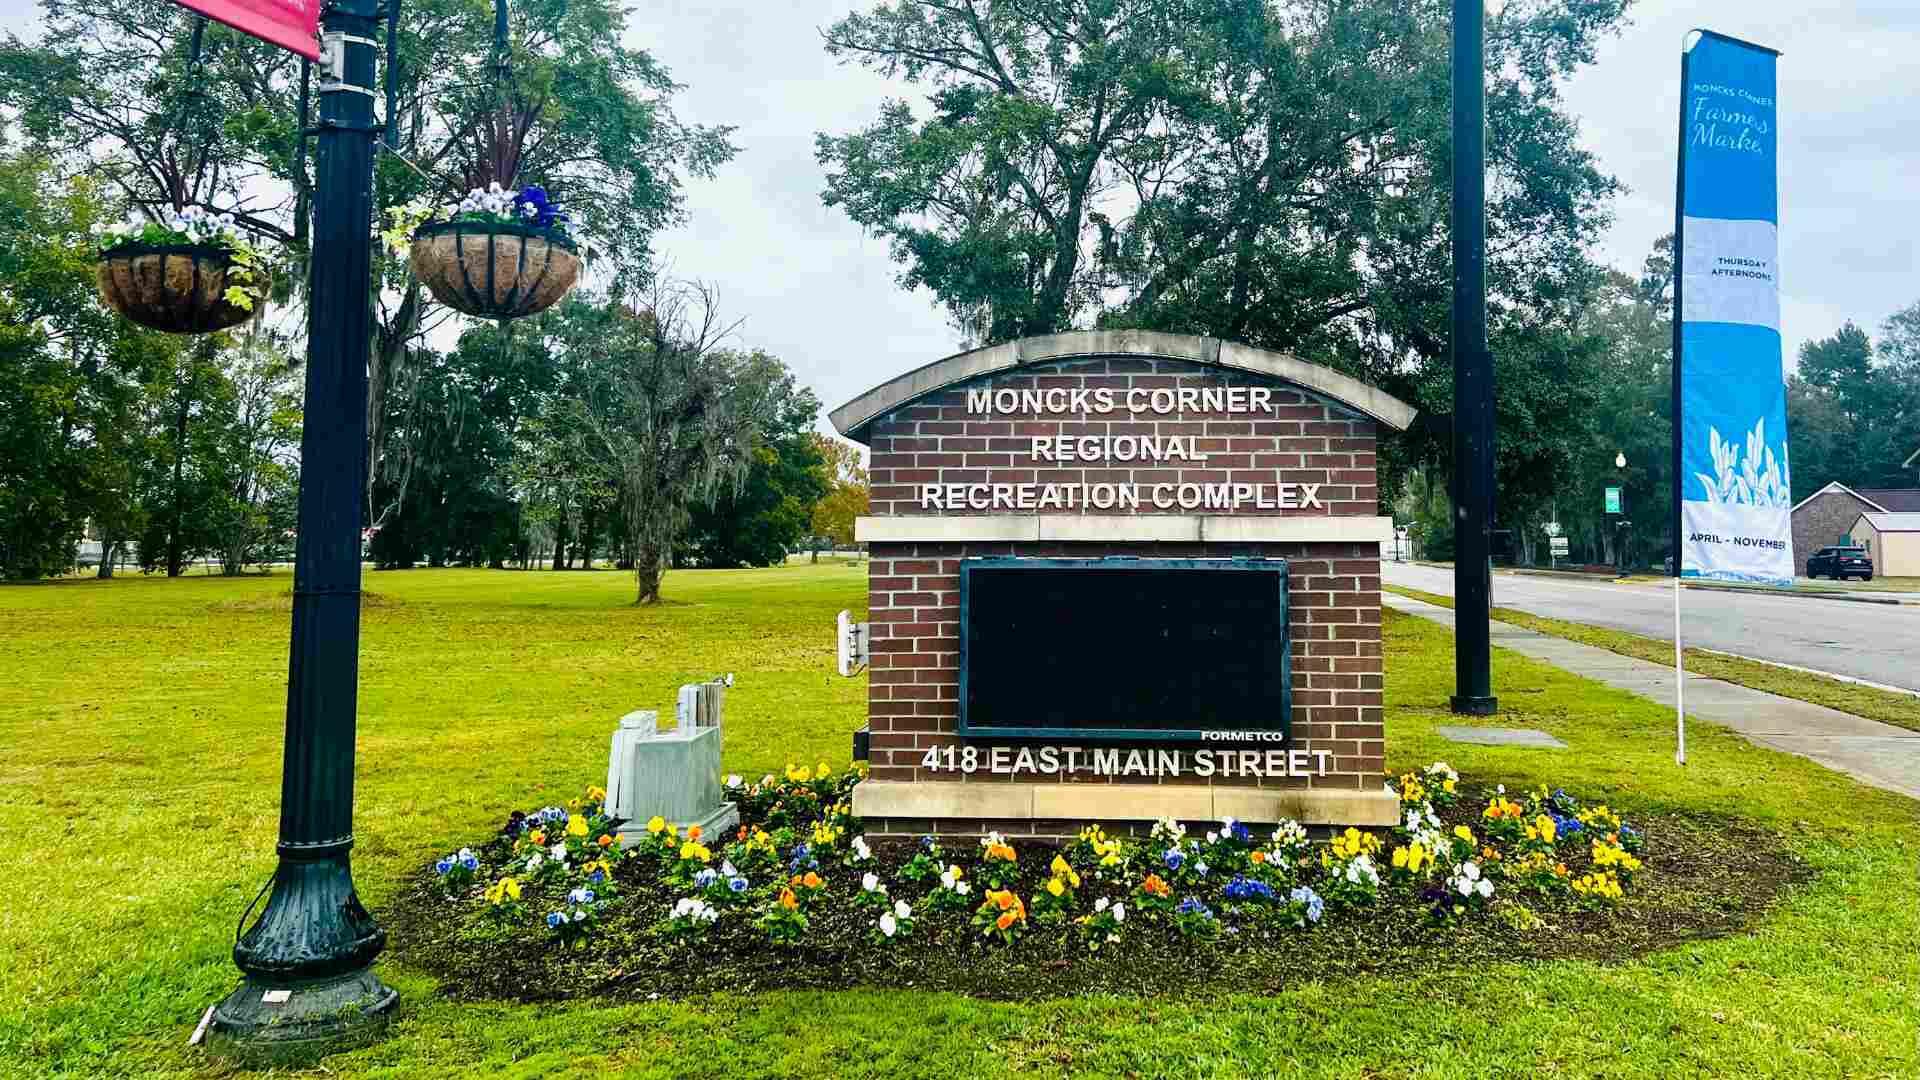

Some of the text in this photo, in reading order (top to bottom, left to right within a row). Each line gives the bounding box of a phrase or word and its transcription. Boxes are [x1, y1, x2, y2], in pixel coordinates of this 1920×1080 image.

[1718, 257, 1767, 269] THURSDAY
[967, 387, 1273, 415] MONCKS CORNER
[1030, 435, 1209, 462] REGIONAL
[921, 482, 1323, 510] RECREATION COMPLEX
[1690, 532, 1722, 544] APRIL
[1734, 537, 1786, 550] NOVEMBER
[1201, 730, 1283, 742] FORMETCO
[921, 744, 1333, 778] 418 EAST MAIN STREET
